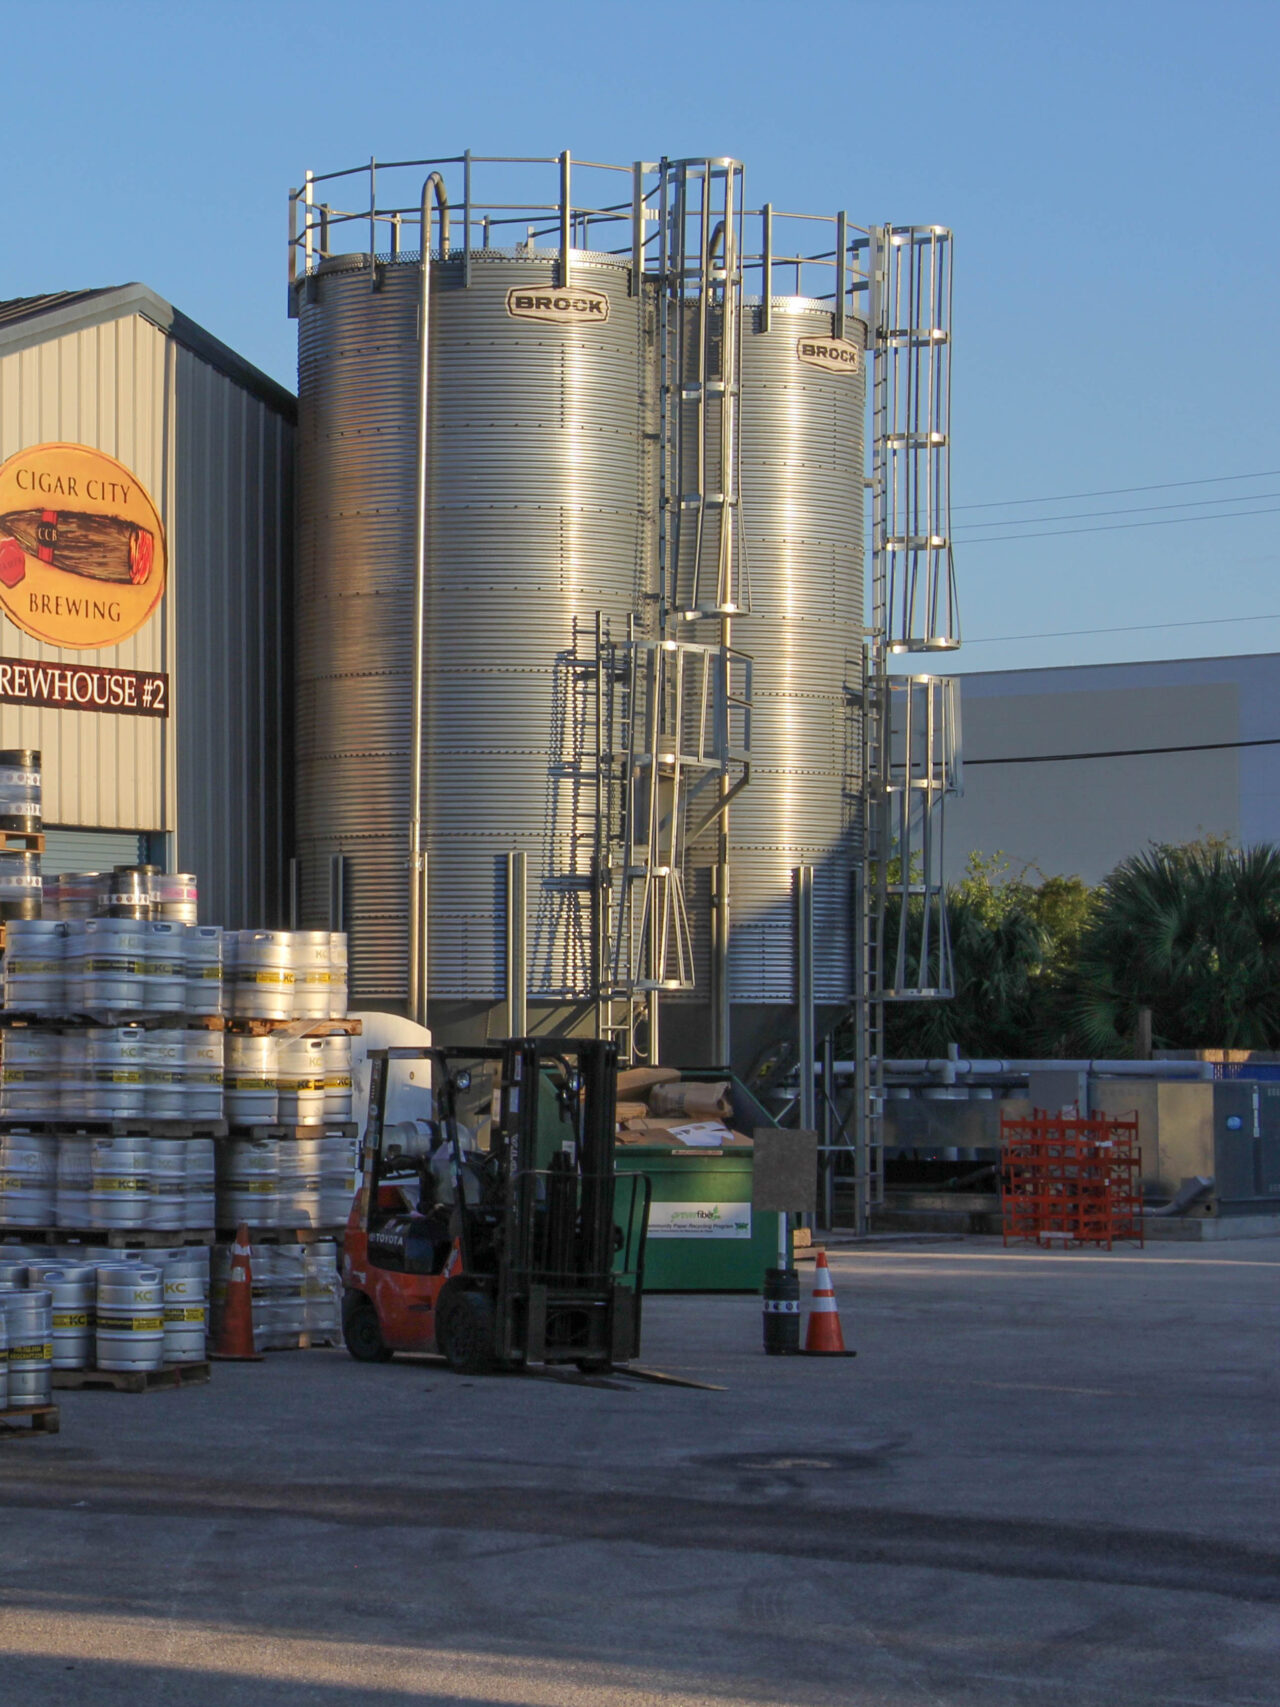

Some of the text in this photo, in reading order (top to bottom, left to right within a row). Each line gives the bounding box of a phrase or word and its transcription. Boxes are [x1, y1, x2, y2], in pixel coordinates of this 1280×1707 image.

[514, 295, 604, 316] BROCK
[801, 343, 859, 365] BROCK
[15, 468, 132, 505] CIGAR CITY
[37, 526, 58, 542] CCB
[28, 592, 122, 623] BREWING
[142, 680, 166, 709] #2
[119, 1179, 135, 1188] KC
[375, 1232, 404, 1246] TOYOTA
[134, 1291, 153, 1301] KC
[165, 1283, 186, 1294] KC
[70, 1315, 85, 1325] KC
